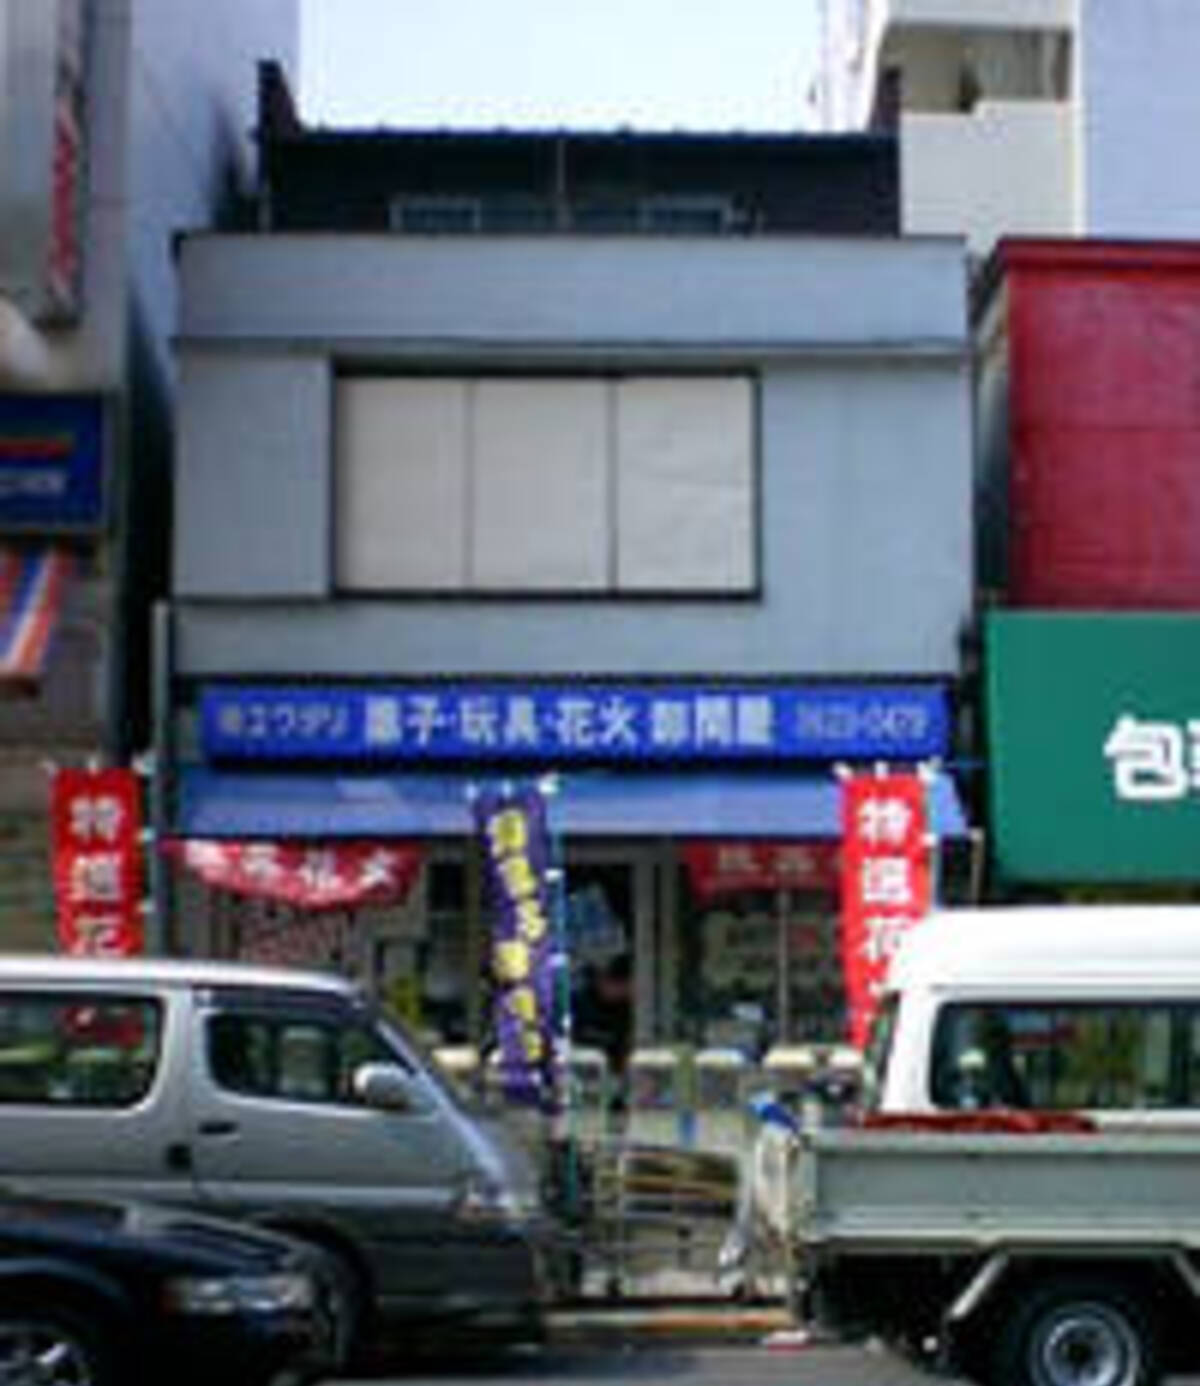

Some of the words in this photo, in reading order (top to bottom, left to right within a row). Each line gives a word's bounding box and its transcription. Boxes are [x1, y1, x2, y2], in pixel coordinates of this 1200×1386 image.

[1103, 713, 1200, 800] 包
[855, 797, 914, 992] 特選花
